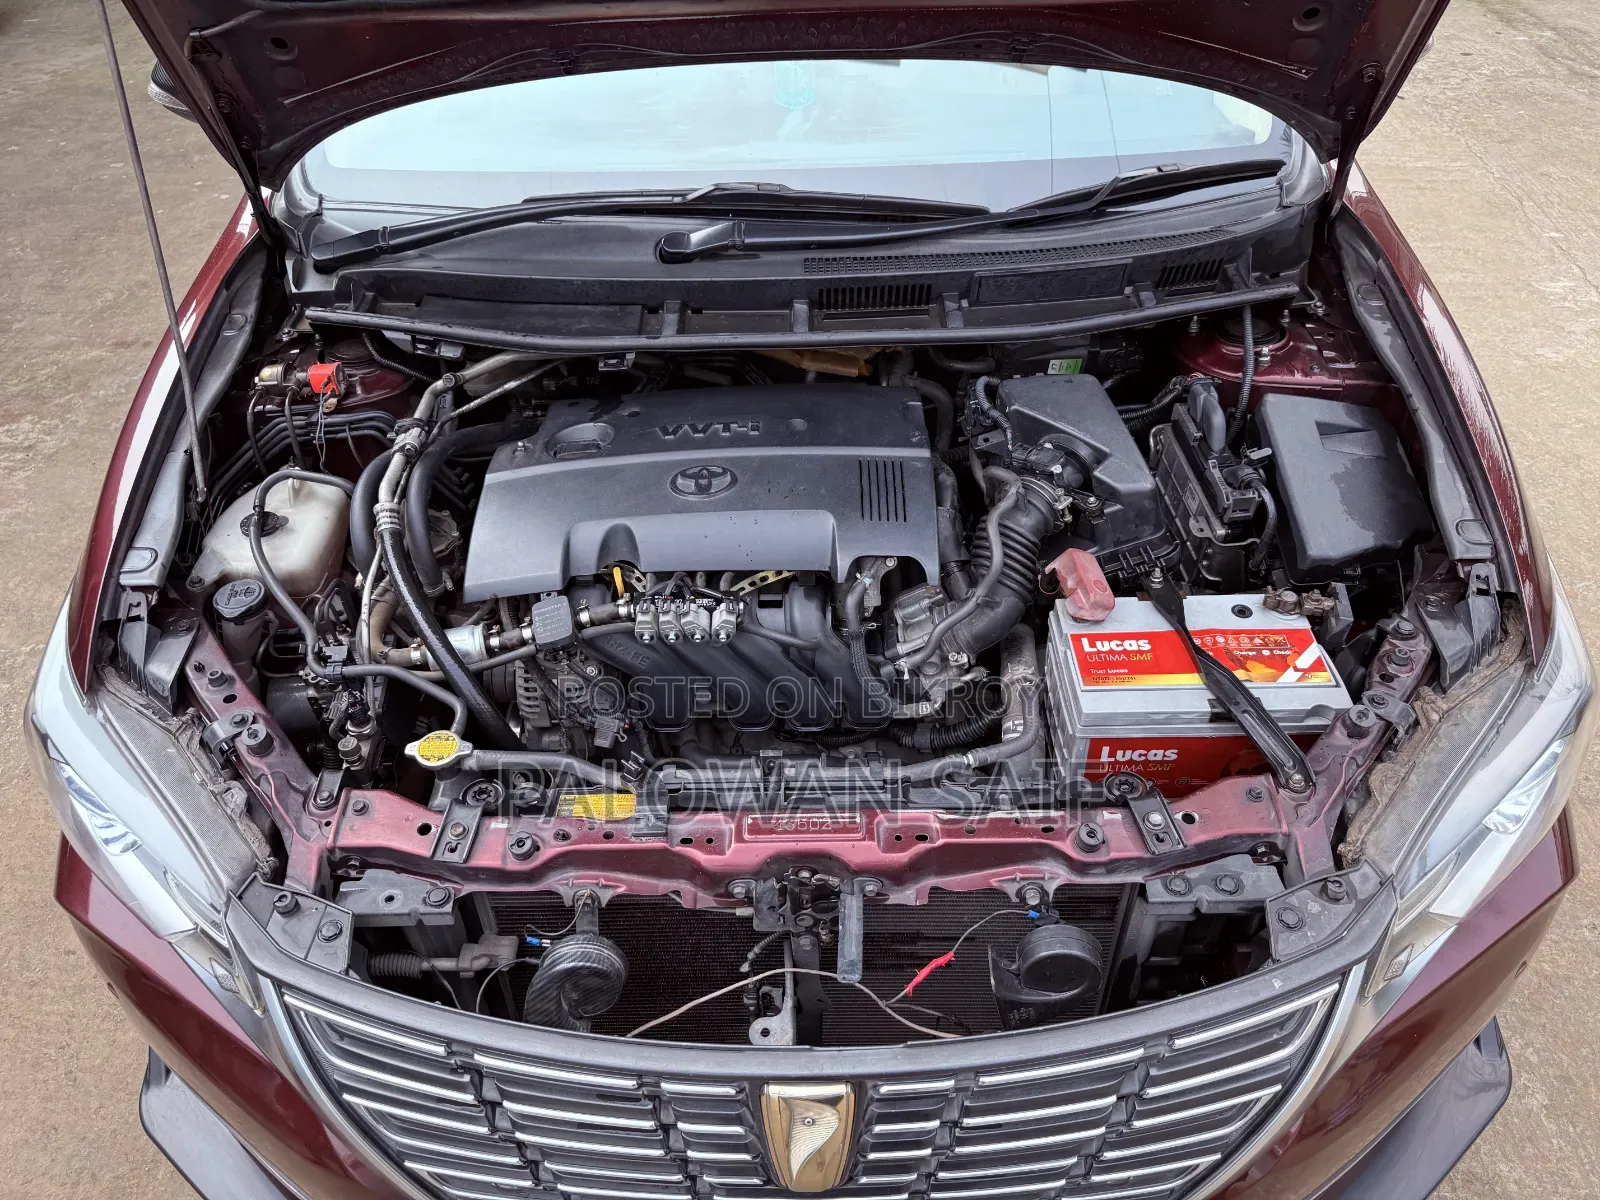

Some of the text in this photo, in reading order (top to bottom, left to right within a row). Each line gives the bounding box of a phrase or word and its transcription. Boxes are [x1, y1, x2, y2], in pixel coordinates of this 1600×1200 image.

[656, 420, 761, 439] VVT-i
[1081, 637, 1152, 652] Lucas
[1087, 653, 1153, 662] ULTIMA SMF
[1099, 746, 1179, 762] Lucas
[1099, 763, 1175, 772] ULTIMA SMF
